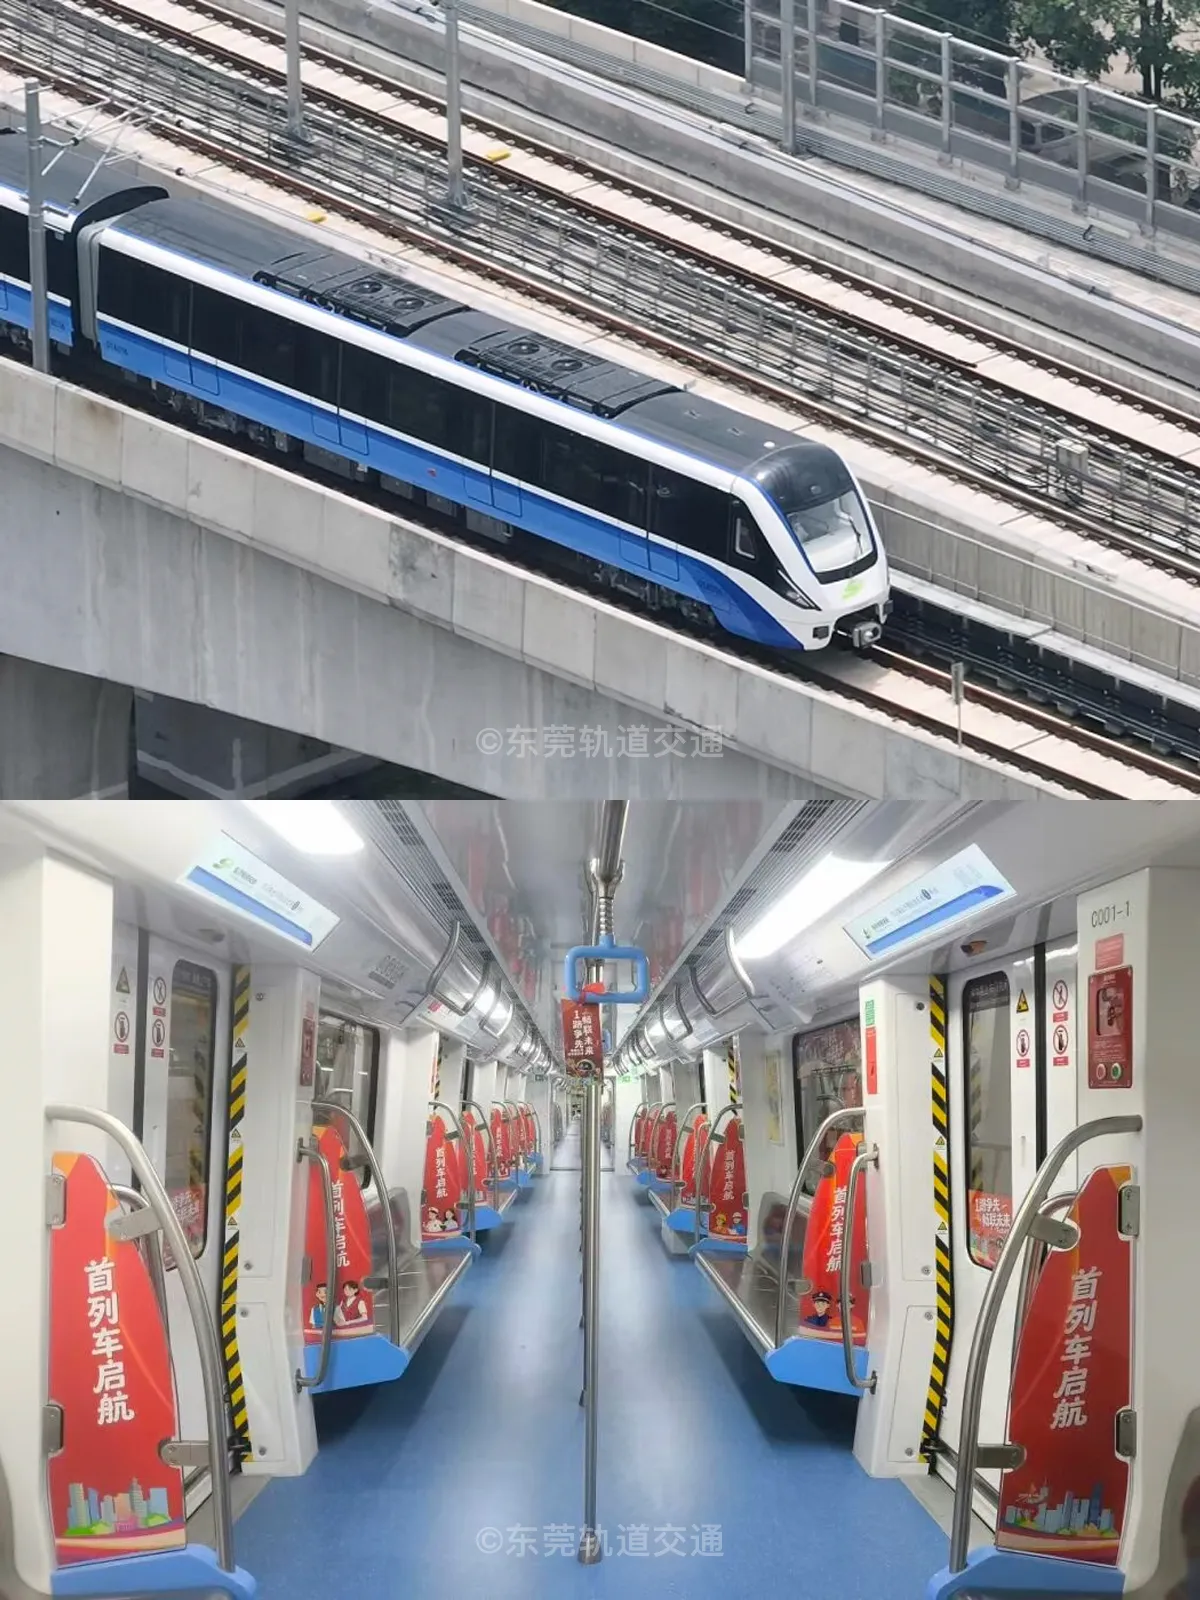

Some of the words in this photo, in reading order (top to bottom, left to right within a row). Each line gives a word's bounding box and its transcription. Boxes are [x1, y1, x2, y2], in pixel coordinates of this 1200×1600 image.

[1091, 901, 1130, 928] C001-1
[436, 1147, 448, 1199] 首列车启航
[722, 1150, 736, 1201] 首列车启航
[84, 1256, 135, 1425] 首列车启航
[1050, 1265, 1103, 1430] 首列车启航
